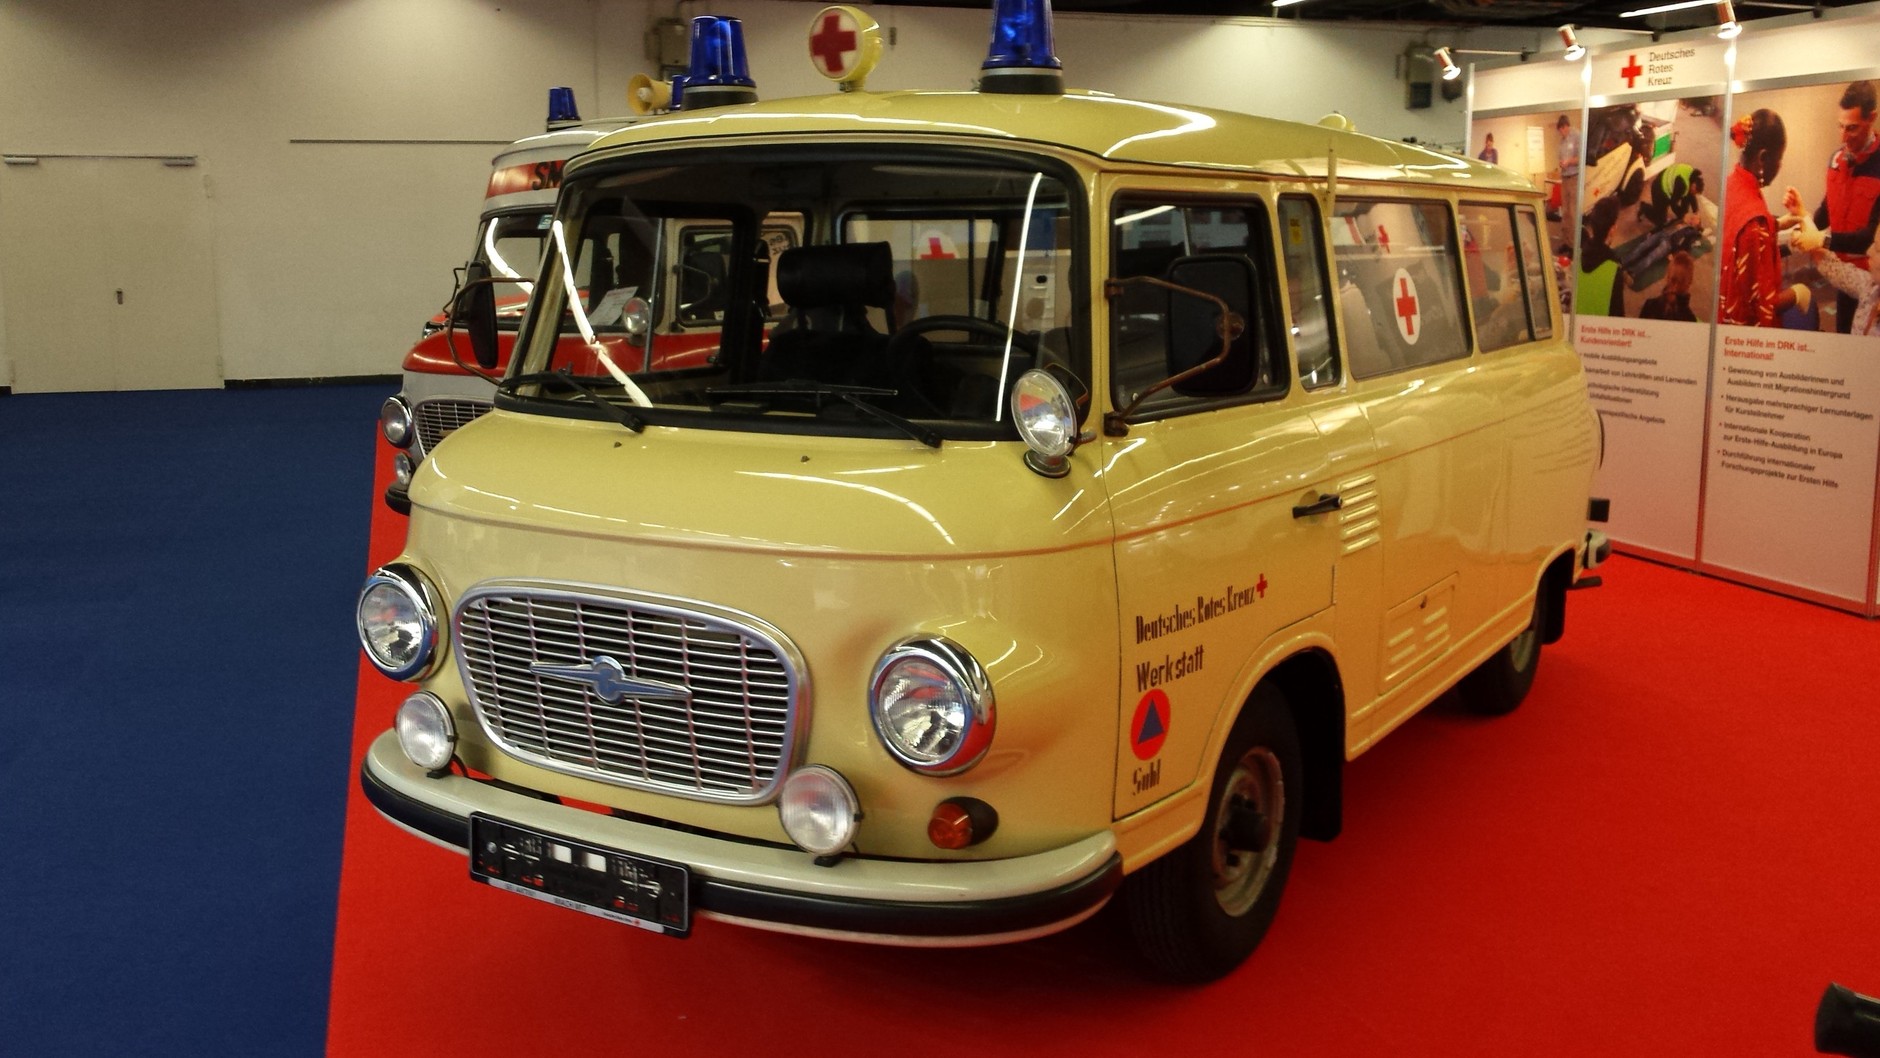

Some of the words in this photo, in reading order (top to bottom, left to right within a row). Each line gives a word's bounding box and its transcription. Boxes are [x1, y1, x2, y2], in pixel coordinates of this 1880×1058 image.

[1649, 48, 1696, 62] Deutsches
[1648, 64, 1674, 74] Rotes
[1647, 77, 1673, 86] Kreuz
[1725, 336, 1744, 346] Erste
[1746, 339, 1764, 348] Hilfe
[1766, 340, 1776, 348] im
[1777, 341, 1795, 350] DRK
[1727, 366, 1764, 378] Gewinnung
[1779, 371, 1829, 385] Ausbilderinnen
[1830, 378, 1845, 386] und
[1727, 377, 1762, 389] Ausbildern
[1775, 383, 1851, 400] Migrationshintergrund
[1724, 405, 1734, 413] für
[1725, 394, 1765, 406] Herausgabe
[1765, 400, 1819, 413] mehrsprachiger
[1820, 406, 1873, 420] Lernunterlagen
[1722, 449, 1766, 465] Durchführung
[1766, 458, 1815, 472] internationaler
[1817, 448, 1843, 460] Europa
[1721, 460, 1786, 479] Forschungsprojekte
[1798, 474, 1821, 486] Ersten
[1136, 604, 1196, 644] Deutsches
[1198, 595, 1226, 623] Rotes
[1227, 585, 1256, 612] Kreuz
[1132, 759, 1162, 796] Suhl
